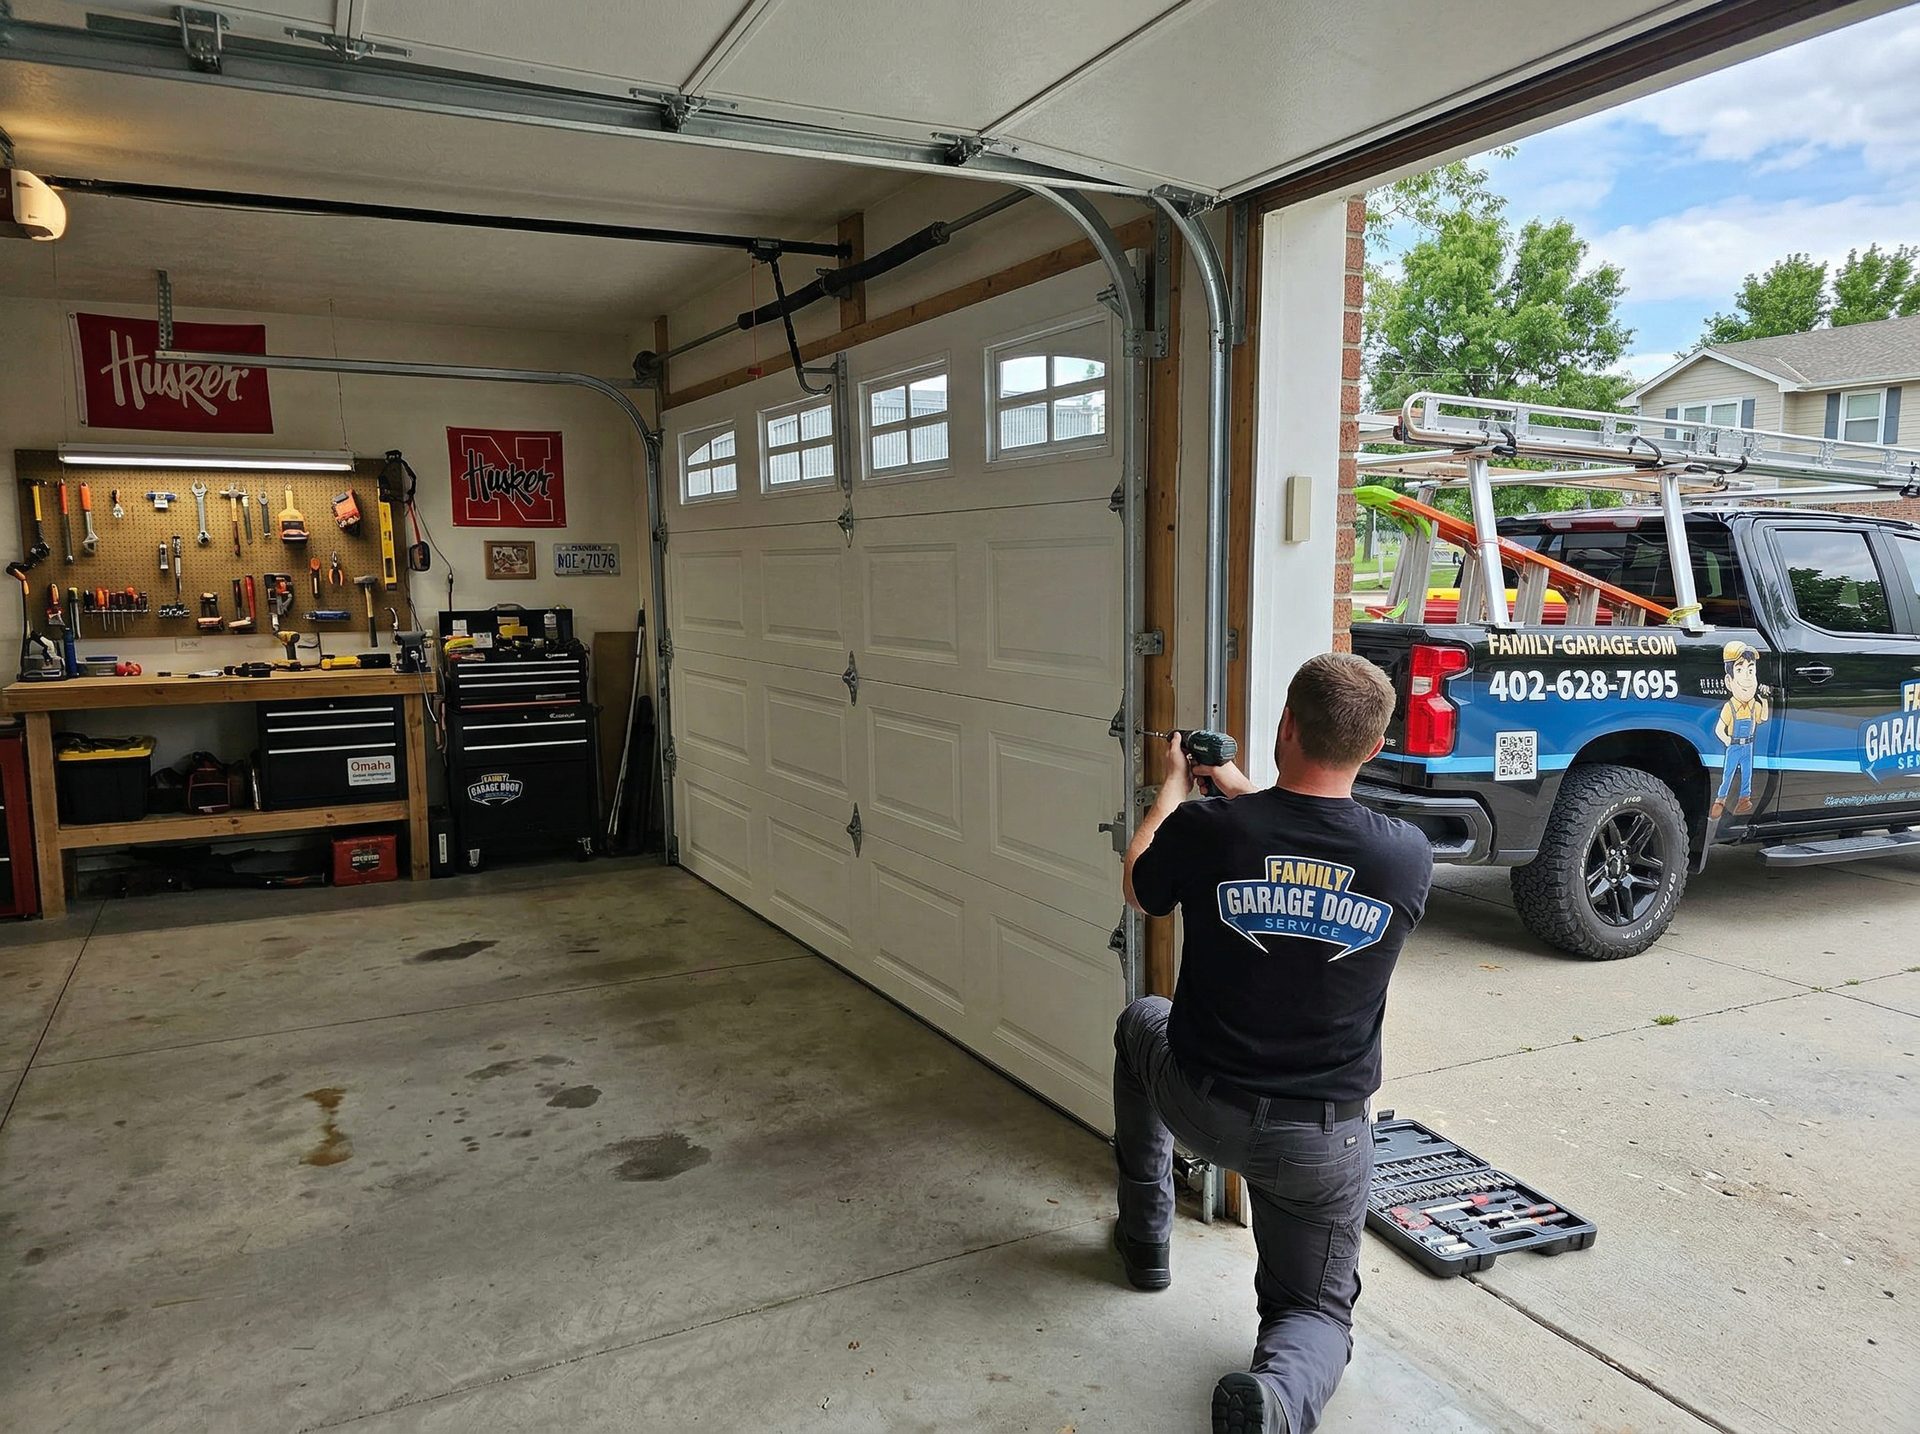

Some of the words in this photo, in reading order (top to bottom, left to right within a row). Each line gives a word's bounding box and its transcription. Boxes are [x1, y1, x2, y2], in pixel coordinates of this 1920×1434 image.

[460, 449, 554, 507] Husker
[1488, 634, 1678, 656] FAMILY-GARAGE.COM
[1489, 669, 1680, 702] 402-628-7695
[351, 760, 391, 772] Omaha
[1270, 860, 1349, 892] FAMILY
[1226, 886, 1316, 918] GARAGE
[1321, 892, 1382, 935] DOOR
[1265, 918, 1341, 938] SERVICE
